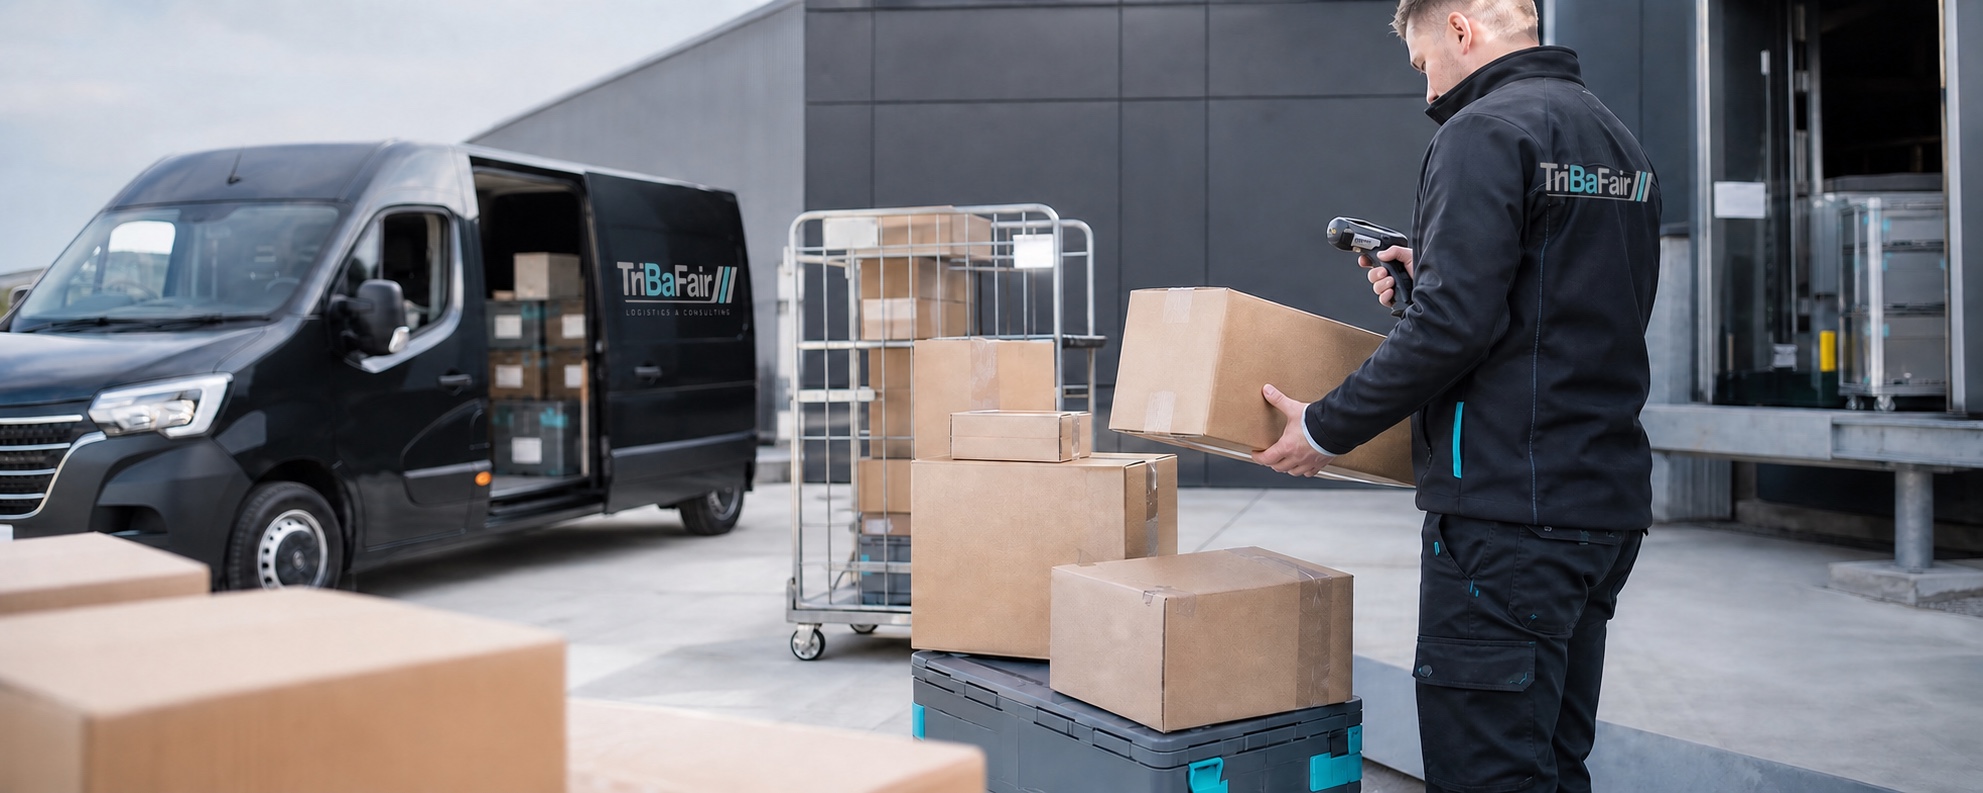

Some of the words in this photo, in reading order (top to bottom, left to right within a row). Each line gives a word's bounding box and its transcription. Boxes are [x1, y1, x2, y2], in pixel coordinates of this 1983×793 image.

[1540, 162, 1632, 196] TriBaFair
[617, 261, 712, 298] TriBaFair
[625, 308, 671, 317] LOGISTICS
[683, 308, 731, 317] CONSULTING
